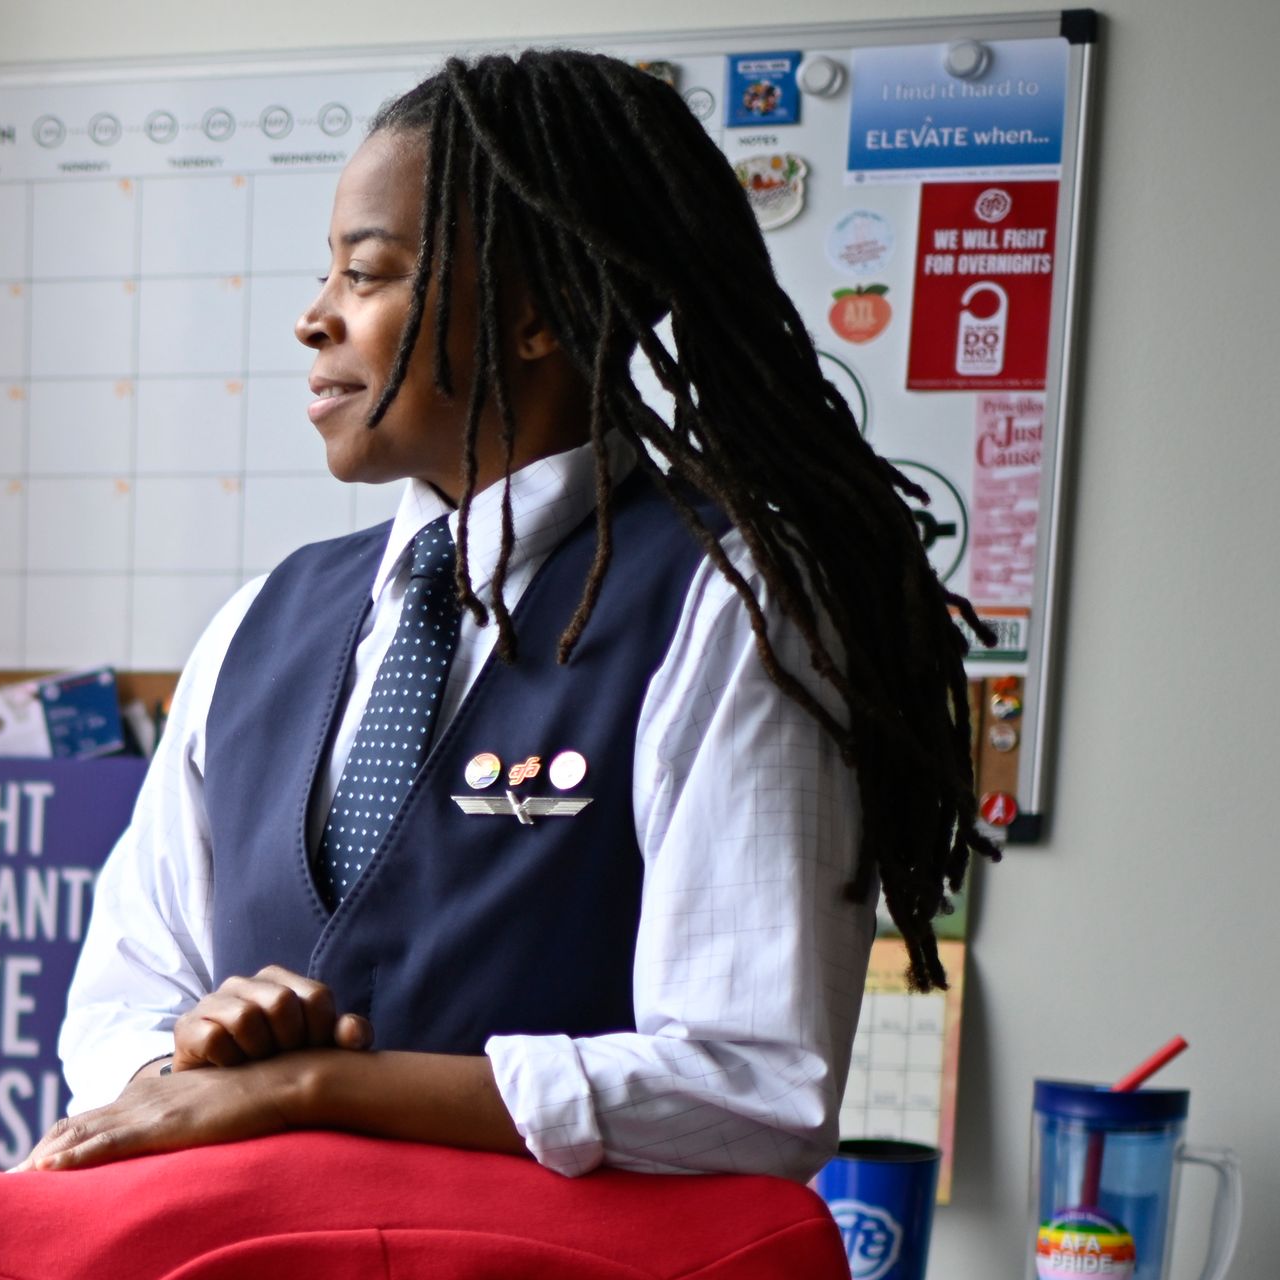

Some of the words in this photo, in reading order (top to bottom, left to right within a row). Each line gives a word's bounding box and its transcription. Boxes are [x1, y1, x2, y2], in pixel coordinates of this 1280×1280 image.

[896, 81, 935, 99] find
[942, 80, 954, 98] it
[962, 79, 1009, 97] hard
[1018, 80, 1039, 96] to
[866, 120, 968, 149] ELEVATE
[934, 228, 958, 250] WE
[962, 228, 999, 250] WILL
[1003, 228, 1047, 249] FIGHT
[925, 254, 954, 276] FOR
[957, 253, 1053, 275] OVERNIGHTS
[964, 331, 999, 348] DO
[963, 348, 996, 360] NOT
[975, 432, 1040, 468] Cause
[1060, 1232, 1101, 1254] AFA
[1052, 1250, 1115, 1275] PRIDE
